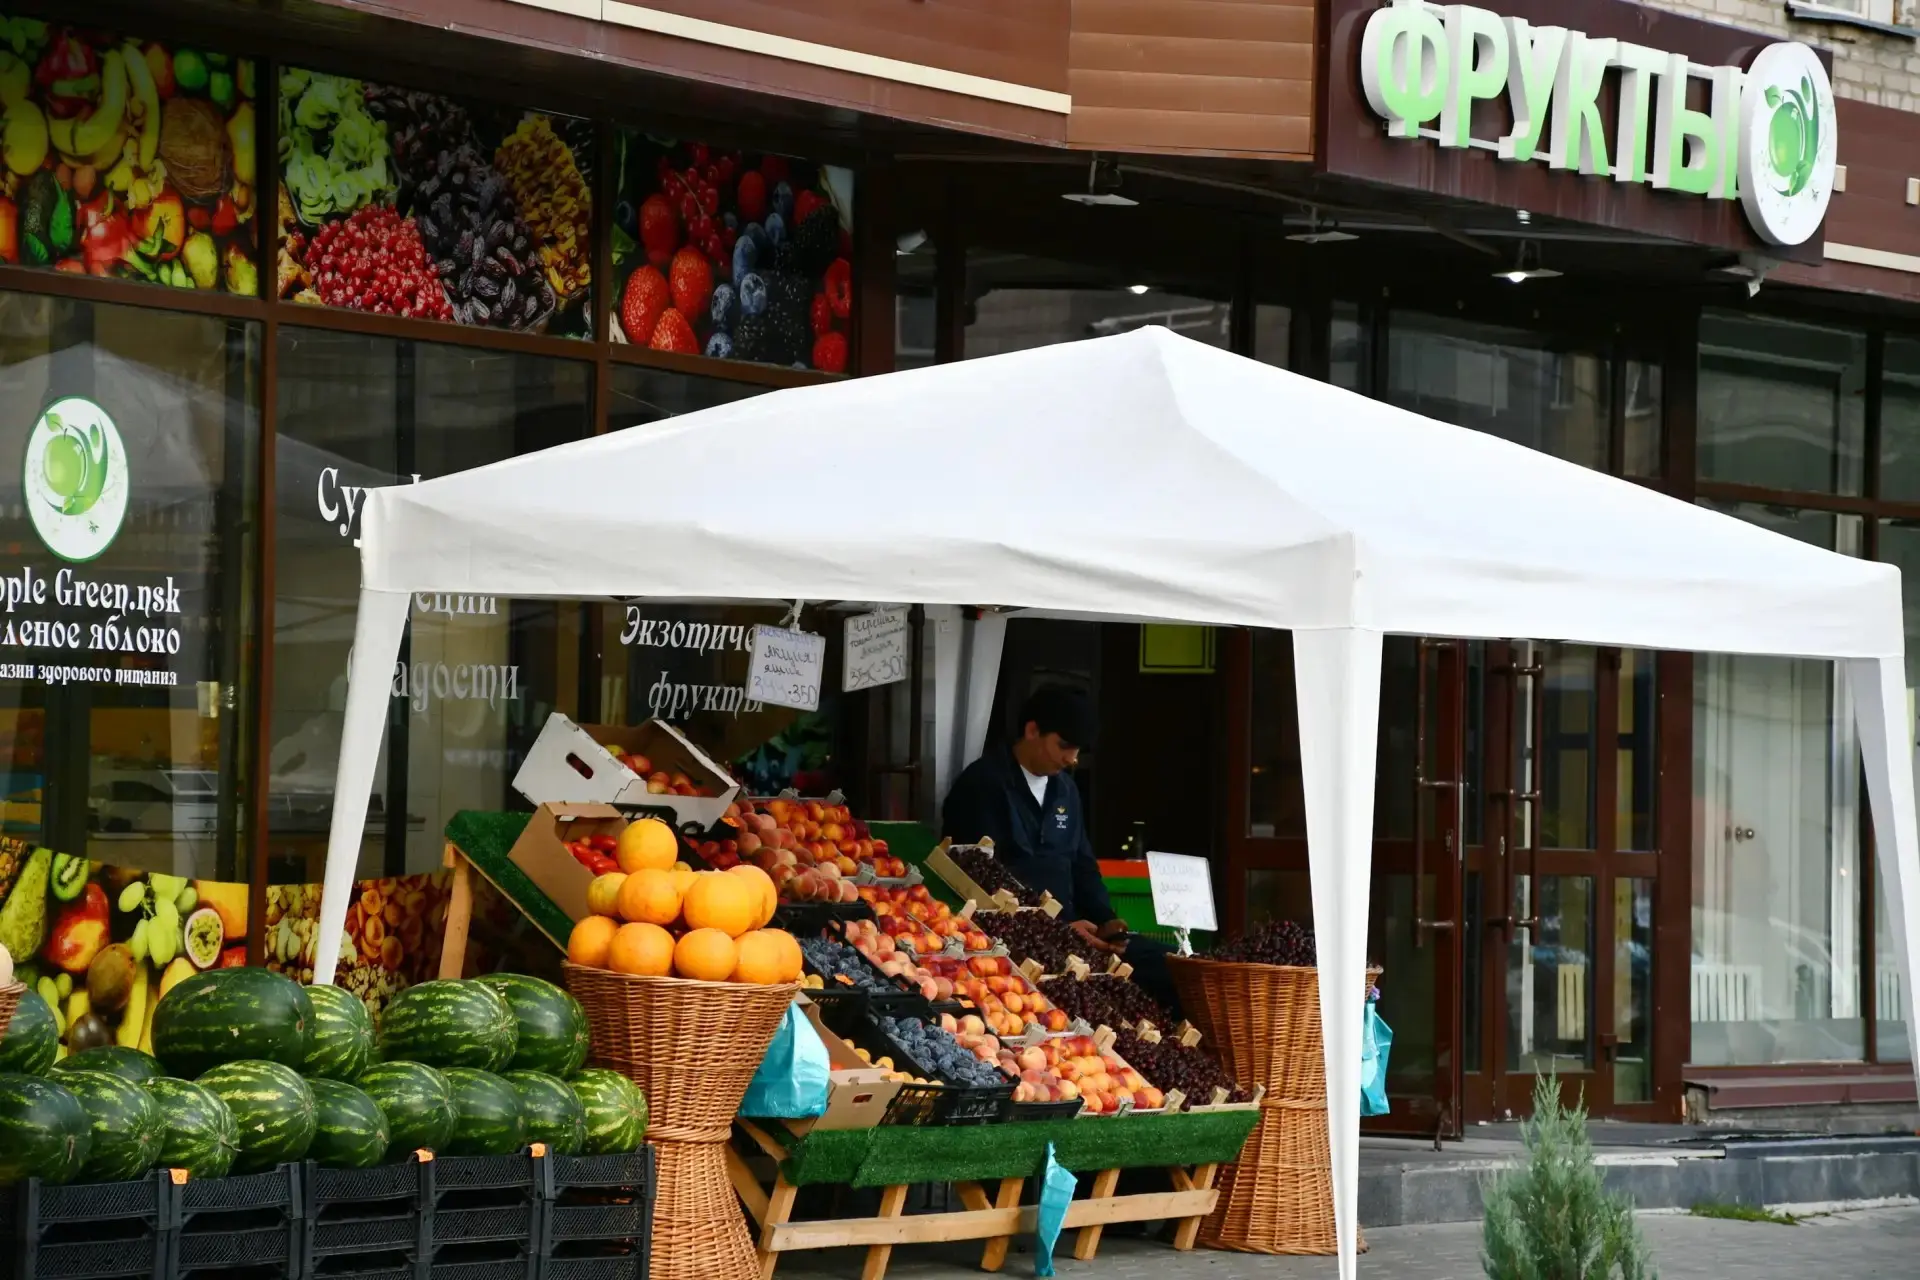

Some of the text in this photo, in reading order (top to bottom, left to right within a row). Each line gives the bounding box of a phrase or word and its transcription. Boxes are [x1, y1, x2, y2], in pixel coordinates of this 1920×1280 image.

[1362, 0, 1744, 199] ФРУКТЫ
[0, 566, 181, 618] ple Green.nsk
[406, 591, 498, 621] еции
[0, 614, 181, 654] леное яблоко
[38, 664, 112, 686] здорового
[115, 668, 177, 688] питания
